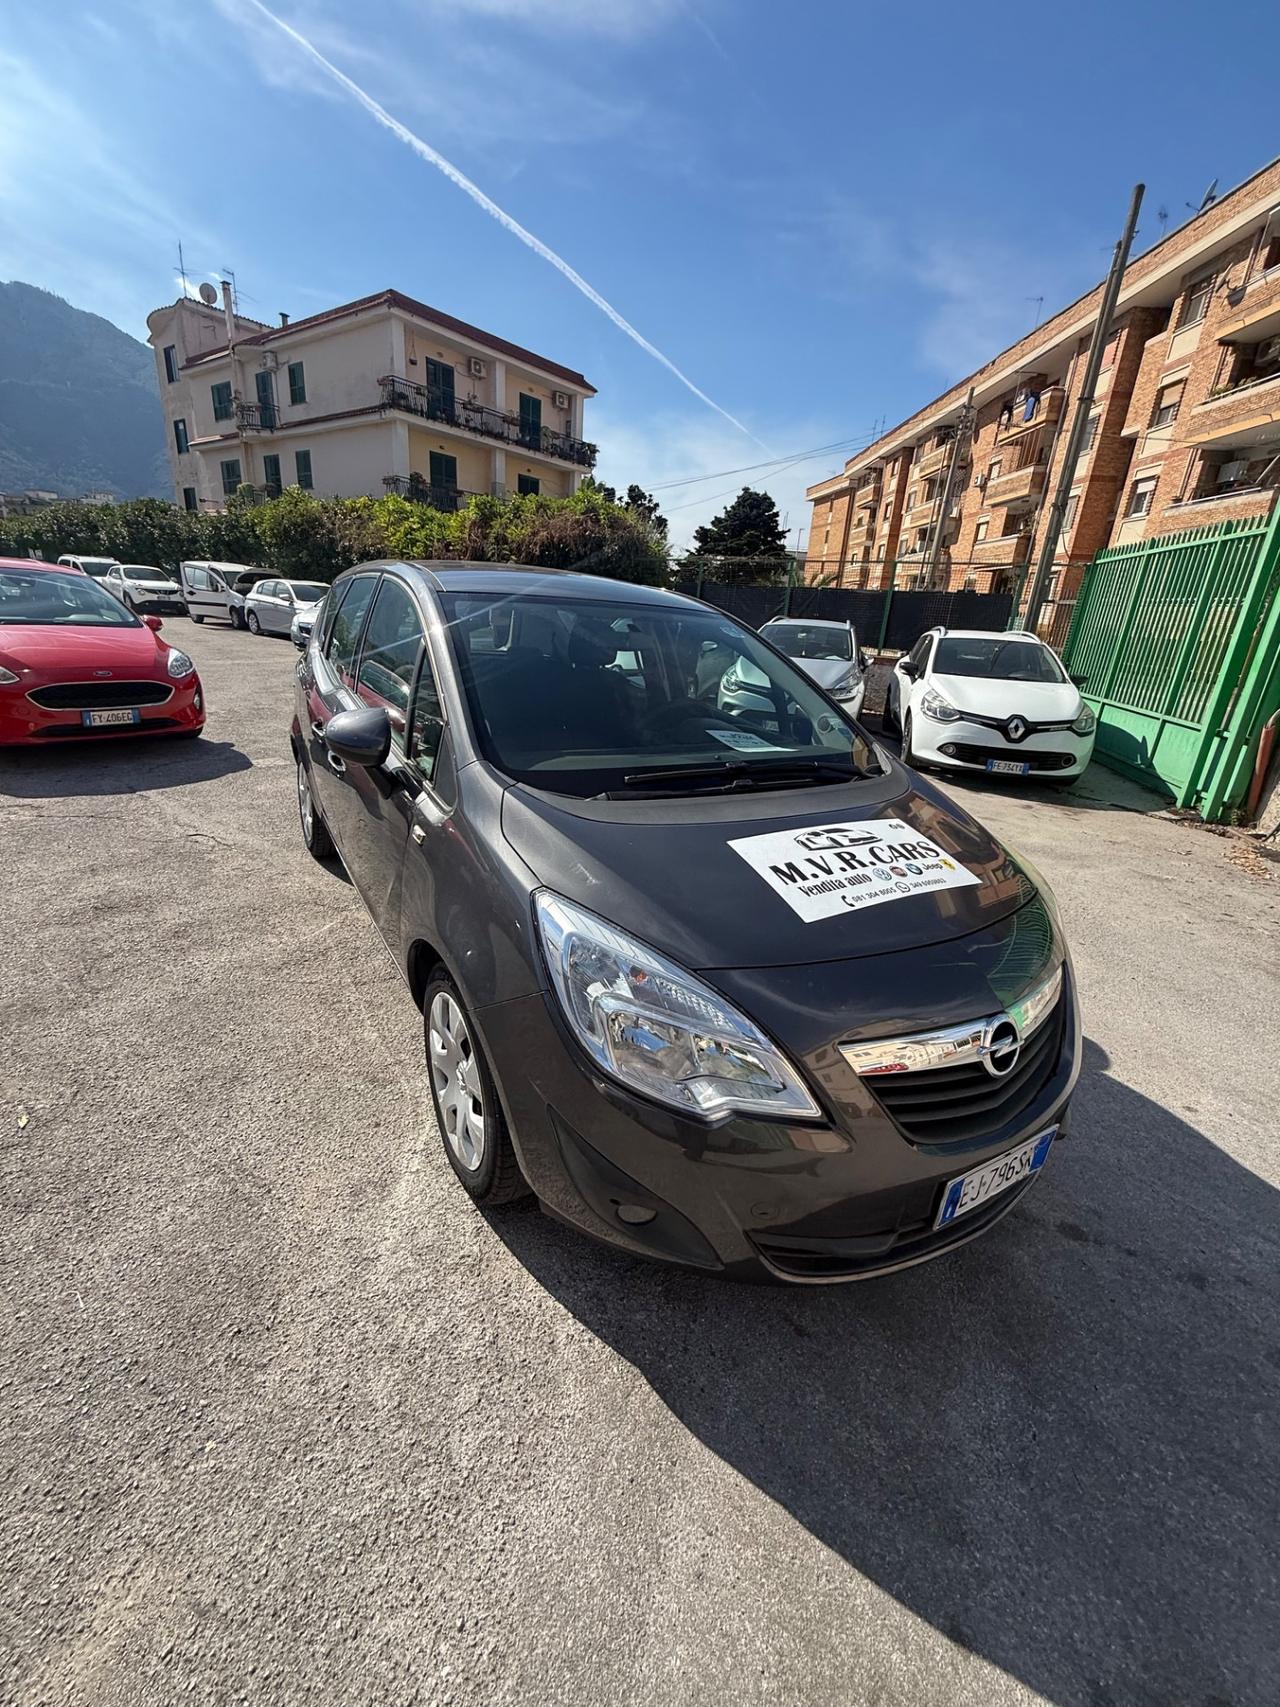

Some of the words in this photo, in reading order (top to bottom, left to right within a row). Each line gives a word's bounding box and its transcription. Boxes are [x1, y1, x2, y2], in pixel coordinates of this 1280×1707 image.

[768, 841, 941, 886] M.V.R.CARS
[797, 876, 846, 898] Vendita
[844, 873, 873, 886] auto
[865, 891, 880, 900] 304
